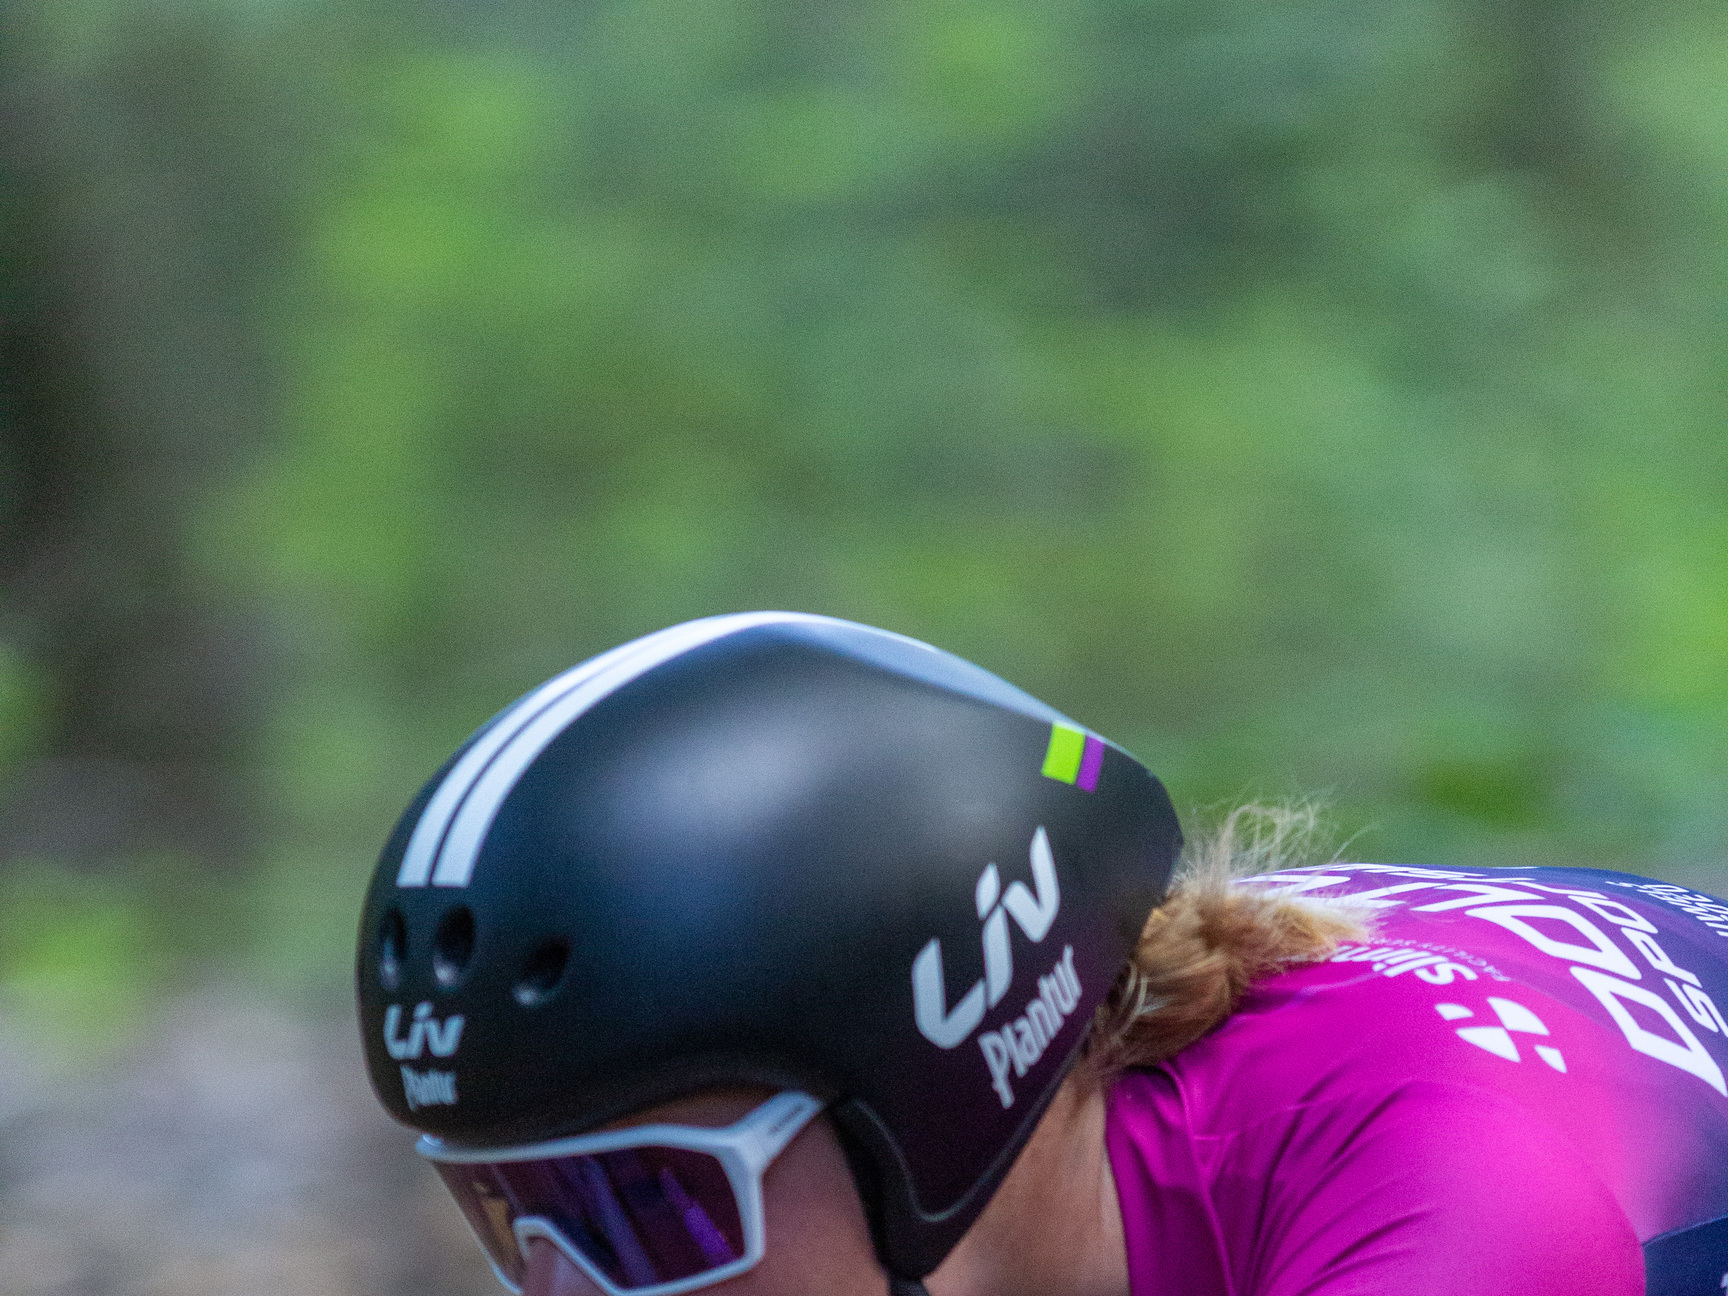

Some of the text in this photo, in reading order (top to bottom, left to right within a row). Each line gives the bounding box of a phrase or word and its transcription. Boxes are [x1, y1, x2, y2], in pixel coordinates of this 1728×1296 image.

[911, 825, 1061, 1050] Liv
[383, 1000, 466, 1061] Liv
[977, 944, 1084, 1109] Plantur
